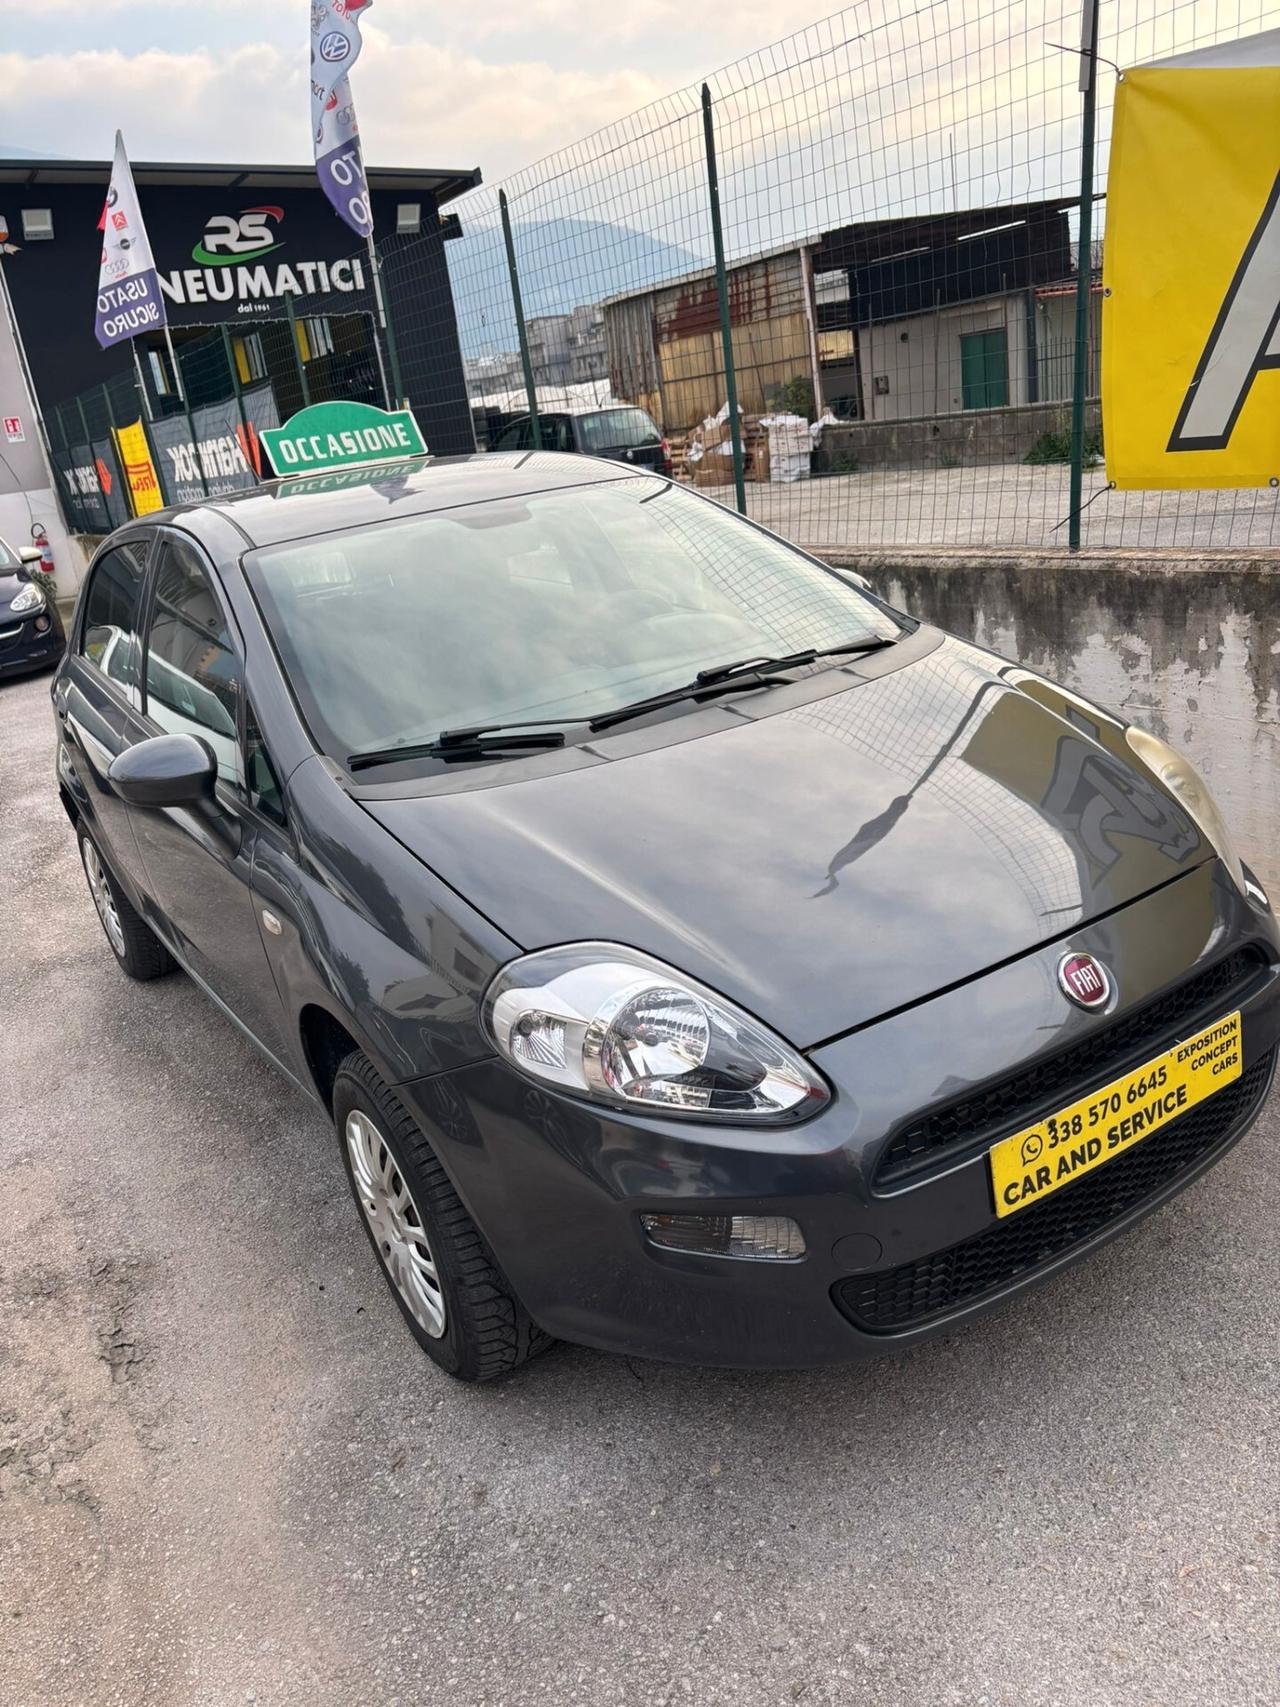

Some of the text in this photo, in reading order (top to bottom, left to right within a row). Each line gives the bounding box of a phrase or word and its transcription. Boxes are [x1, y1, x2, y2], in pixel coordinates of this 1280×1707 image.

[203, 213, 275, 253] RS
[155, 258, 366, 304] NEUMATICI
[237, 302, 254, 314] dal
[278, 421, 411, 464] OCCASIONE
[1070, 963, 1102, 996] FIAT
[1176, 1018, 1238, 1063] EXPOSITION
[1190, 1036, 1239, 1072] CONCEPT
[1211, 1052, 1239, 1076] CARS
[1047, 1065, 1169, 1150] 338 570 6645
[1003, 1083, 1188, 1206] CAR AND SERVICE
